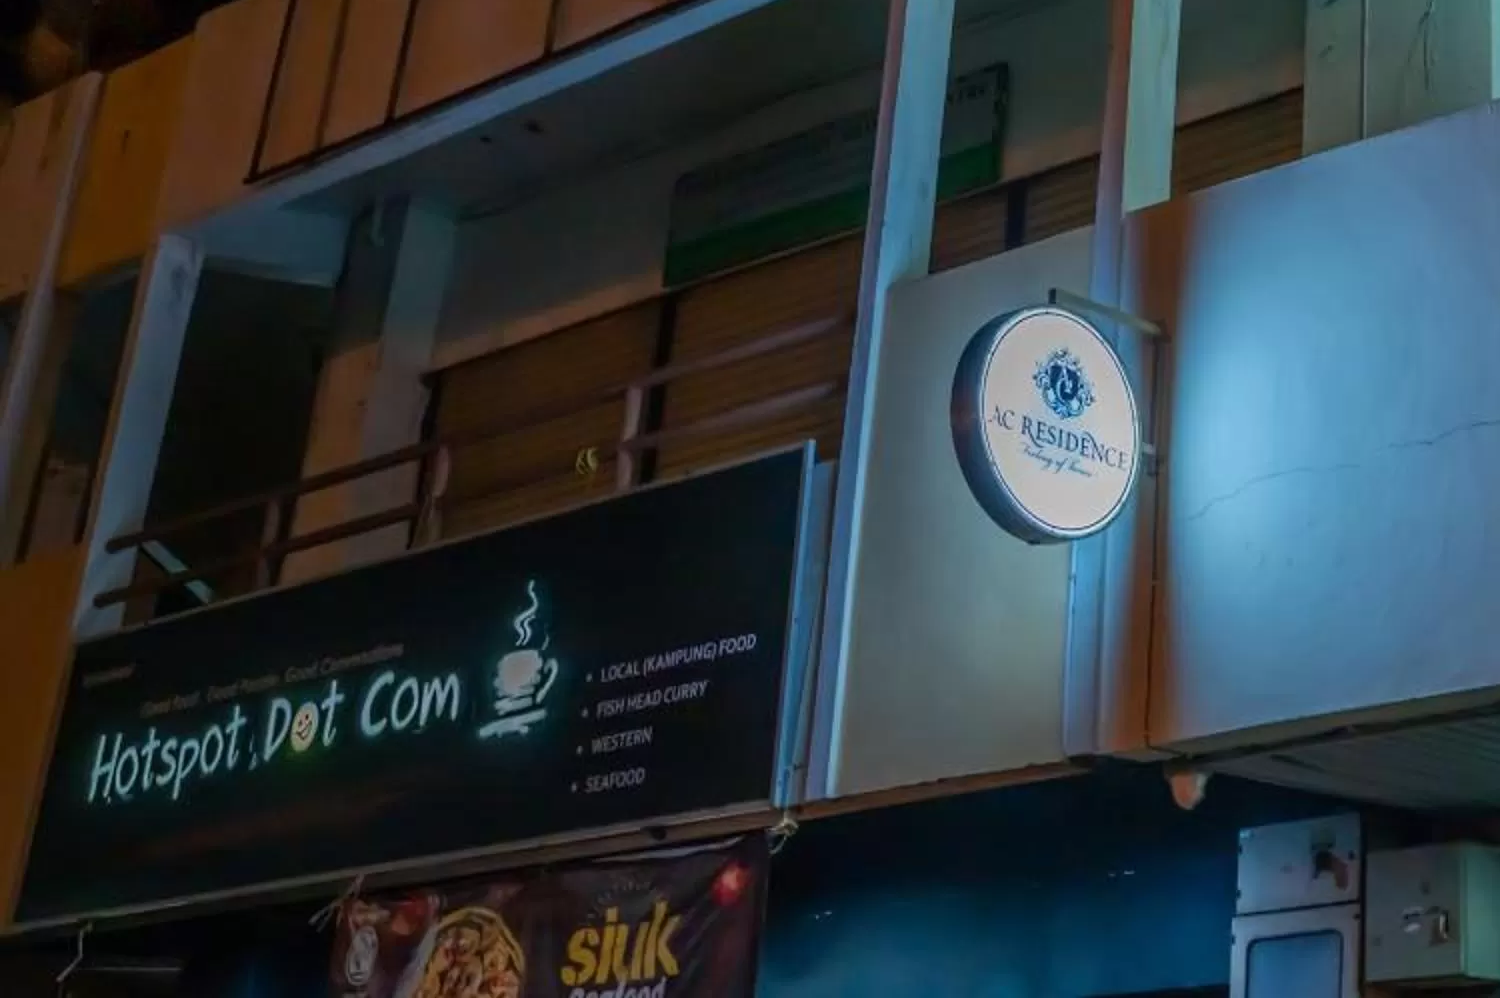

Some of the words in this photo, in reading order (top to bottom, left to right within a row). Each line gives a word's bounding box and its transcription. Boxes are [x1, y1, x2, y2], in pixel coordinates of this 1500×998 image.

[988, 404, 1016, 431] AC
[1020, 414, 1130, 470] RESIDENCE
[600, 660, 641, 683] LOCAL
[642, 640, 718, 676] (KAMPUNG)
[718, 633, 758, 656] FOOD
[263, 679, 345, 764] Dot
[360, 669, 462, 738] Com
[596, 698, 626, 720] FISH
[626, 688, 662, 711] HEAD
[663, 679, 710, 704] CURRY
[591, 725, 654, 755] WESTERN
[585, 766, 646, 793] SEAFOOD
